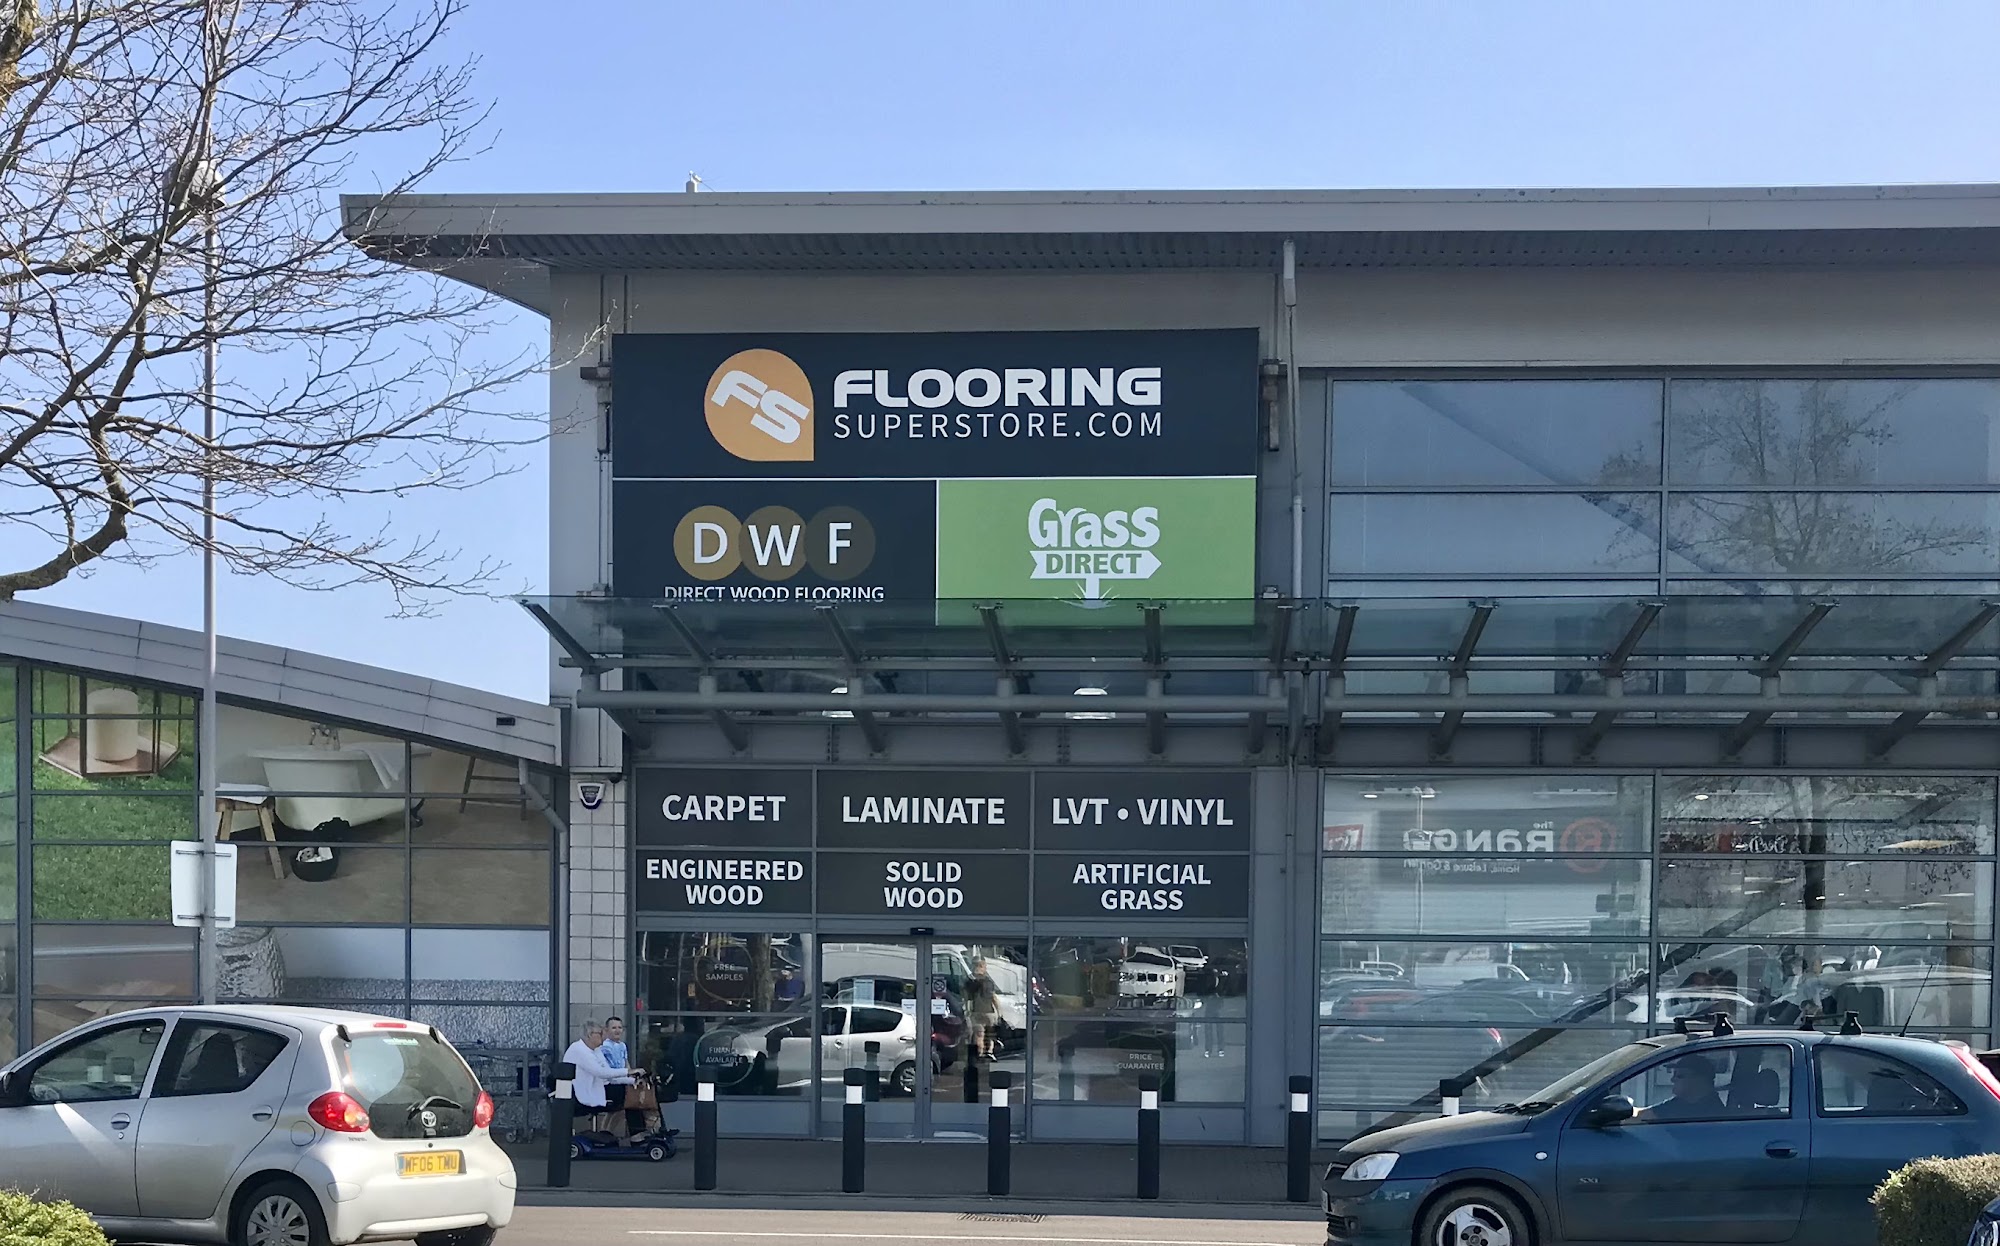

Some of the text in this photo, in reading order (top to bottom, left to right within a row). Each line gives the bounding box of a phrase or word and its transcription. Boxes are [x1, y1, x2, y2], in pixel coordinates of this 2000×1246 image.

[833, 367, 1162, 408] FLOORING
[711, 370, 810, 444] FS
[834, 411, 1162, 439] SUPERSTORE.COM
[1028, 498, 1161, 548] Grass
[1046, 554, 1142, 574] DIRECT
[664, 586, 884, 603] DIRECT WOOD FLOORING
[662, 794, 786, 822] CARPET
[842, 796, 1005, 825] LAMINATE
[1052, 797, 1234, 826] LVT VINYL
[646, 858, 804, 881] ENGINEERED
[886, 861, 962, 883] SOLID
[1072, 863, 1212, 885] ARTIFICIAL
[685, 884, 764, 906] WOOD
[883, 887, 964, 909] WOOD
[1100, 889, 1184, 911] GRASS
[705, 973, 744, 981] SAMPLES
[1117, 1062, 1165, 1071] GUARANTEE
[1129, 1053, 1153, 1061] PRICE
